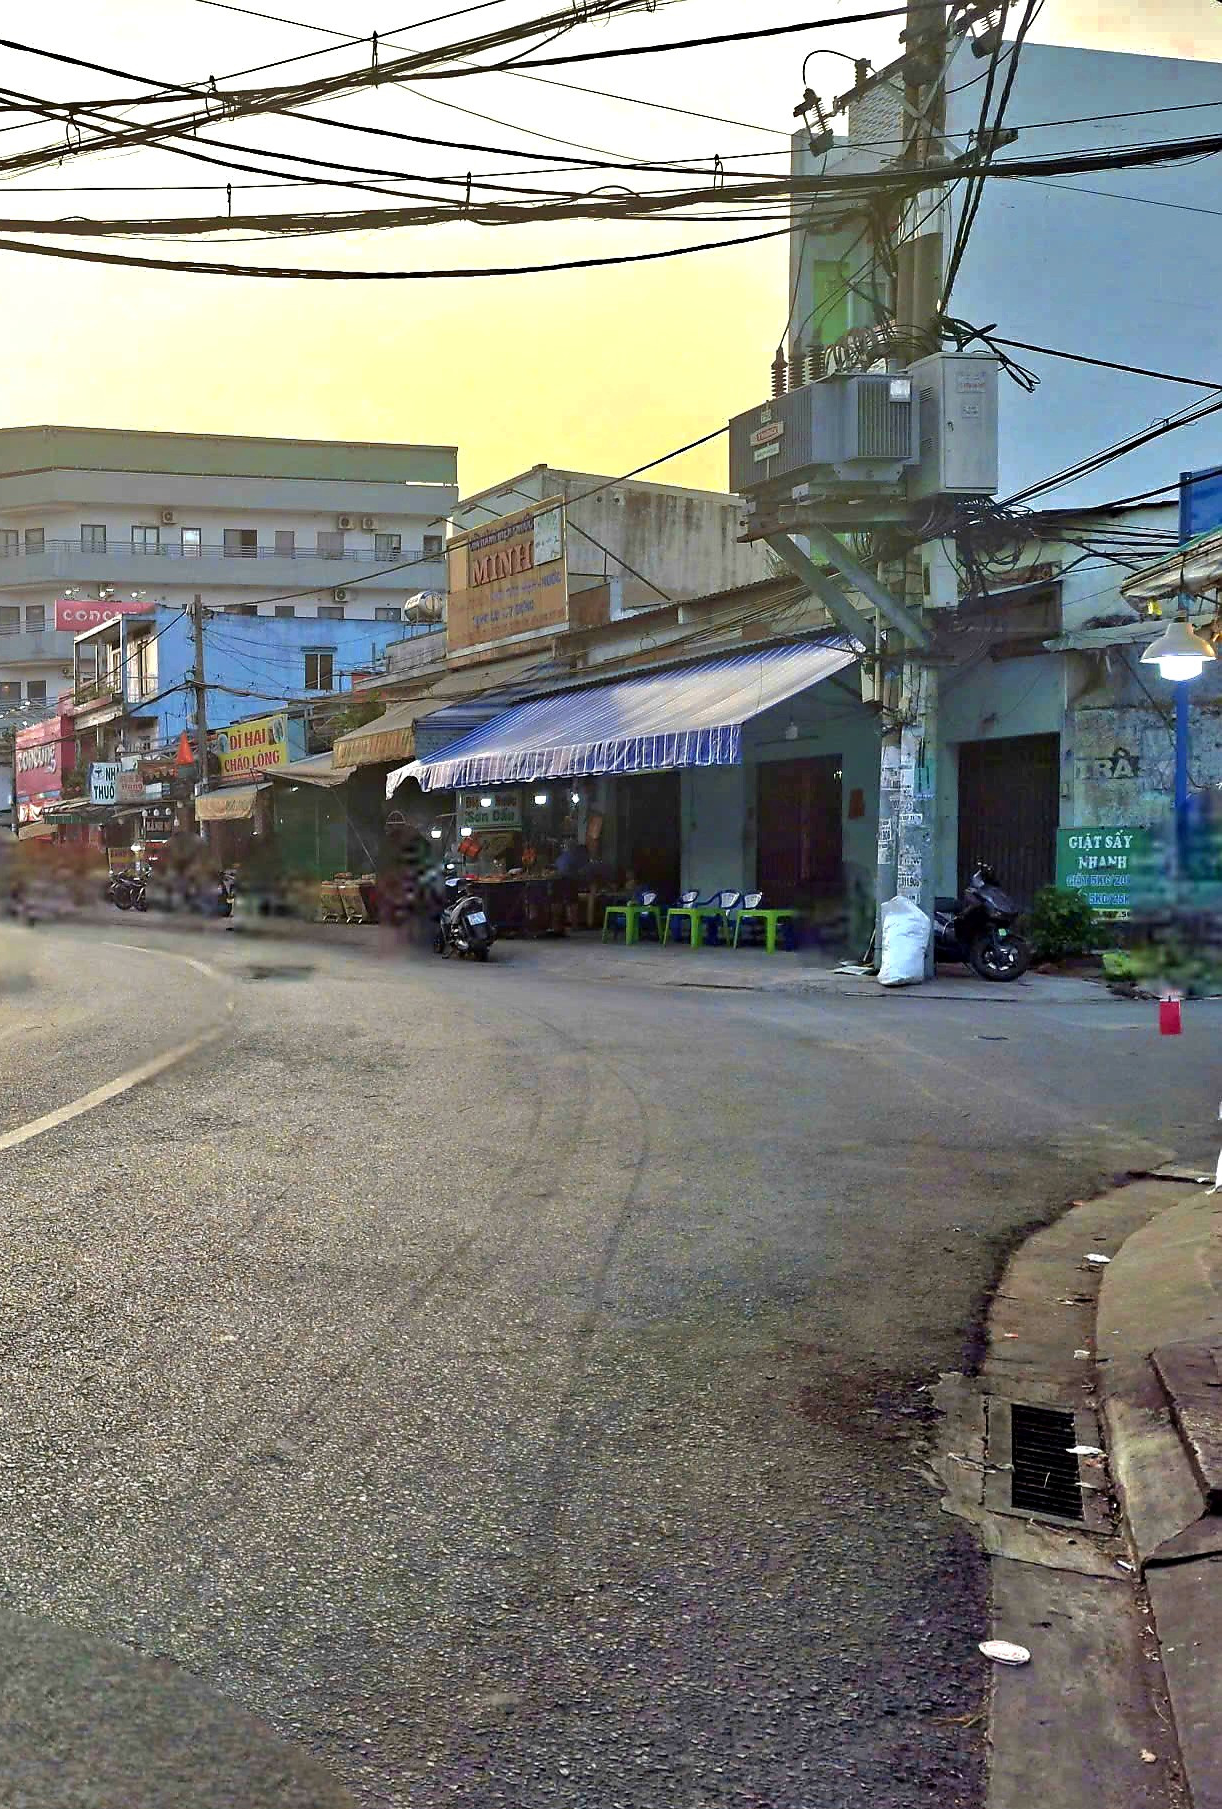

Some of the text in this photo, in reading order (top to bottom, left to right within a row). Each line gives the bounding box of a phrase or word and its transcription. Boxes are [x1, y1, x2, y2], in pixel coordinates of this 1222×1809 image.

[472, 540, 534, 588] MINH
[245, 728, 266, 747] HAI
[224, 750, 280, 772] CHÁO LÒNG
[94, 781, 115, 800] THUỐ
[1068, 829, 1133, 851] GIẶT SẤY
[1078, 855, 1127, 869] NHANH
